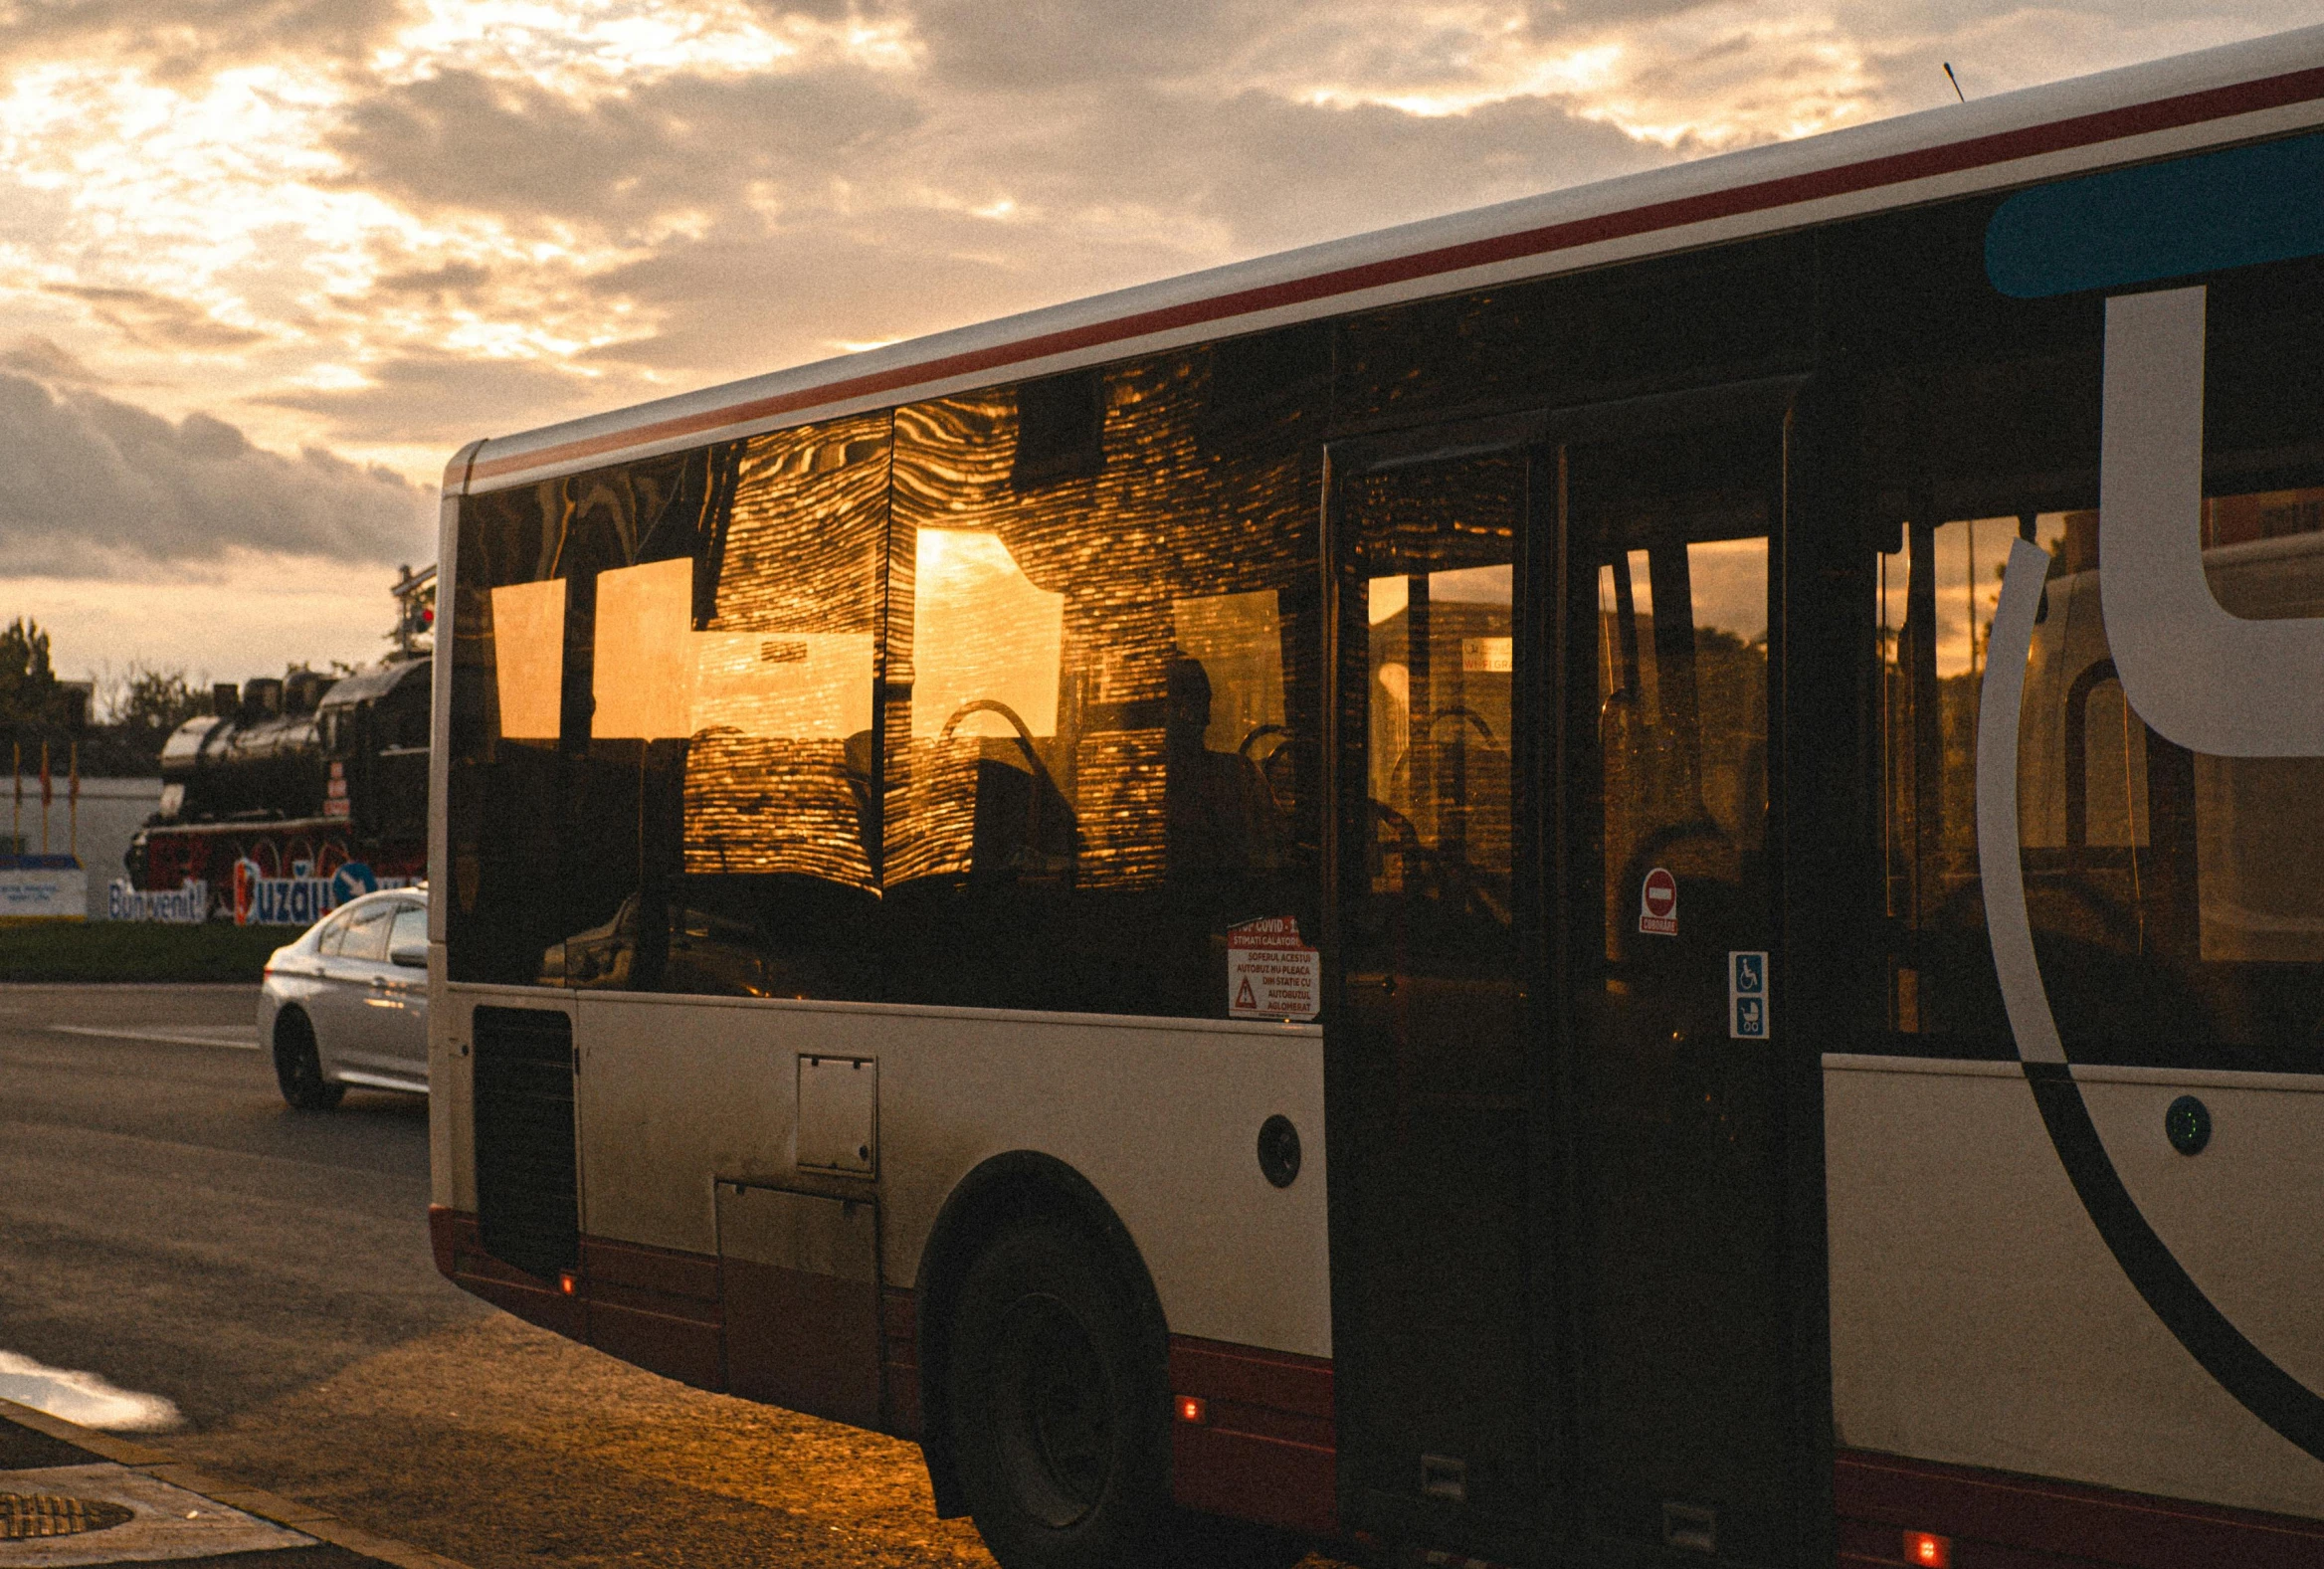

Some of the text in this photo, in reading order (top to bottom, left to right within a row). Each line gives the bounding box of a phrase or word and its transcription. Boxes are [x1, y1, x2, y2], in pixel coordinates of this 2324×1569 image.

[1256, 918, 1283, 933] COVID
[1280, 953, 1311, 962] ACESTUI
[1237, 964, 1269, 974] AUTOBUZ
[1270, 965, 1281, 974] NU
[1262, 976, 1275, 985] DIN
[1301, 978, 1311, 987] CU
[1268, 989, 1311, 1000] AUTOBUZUL
[1267, 1001, 1311, 1012] AGLOMERAT
